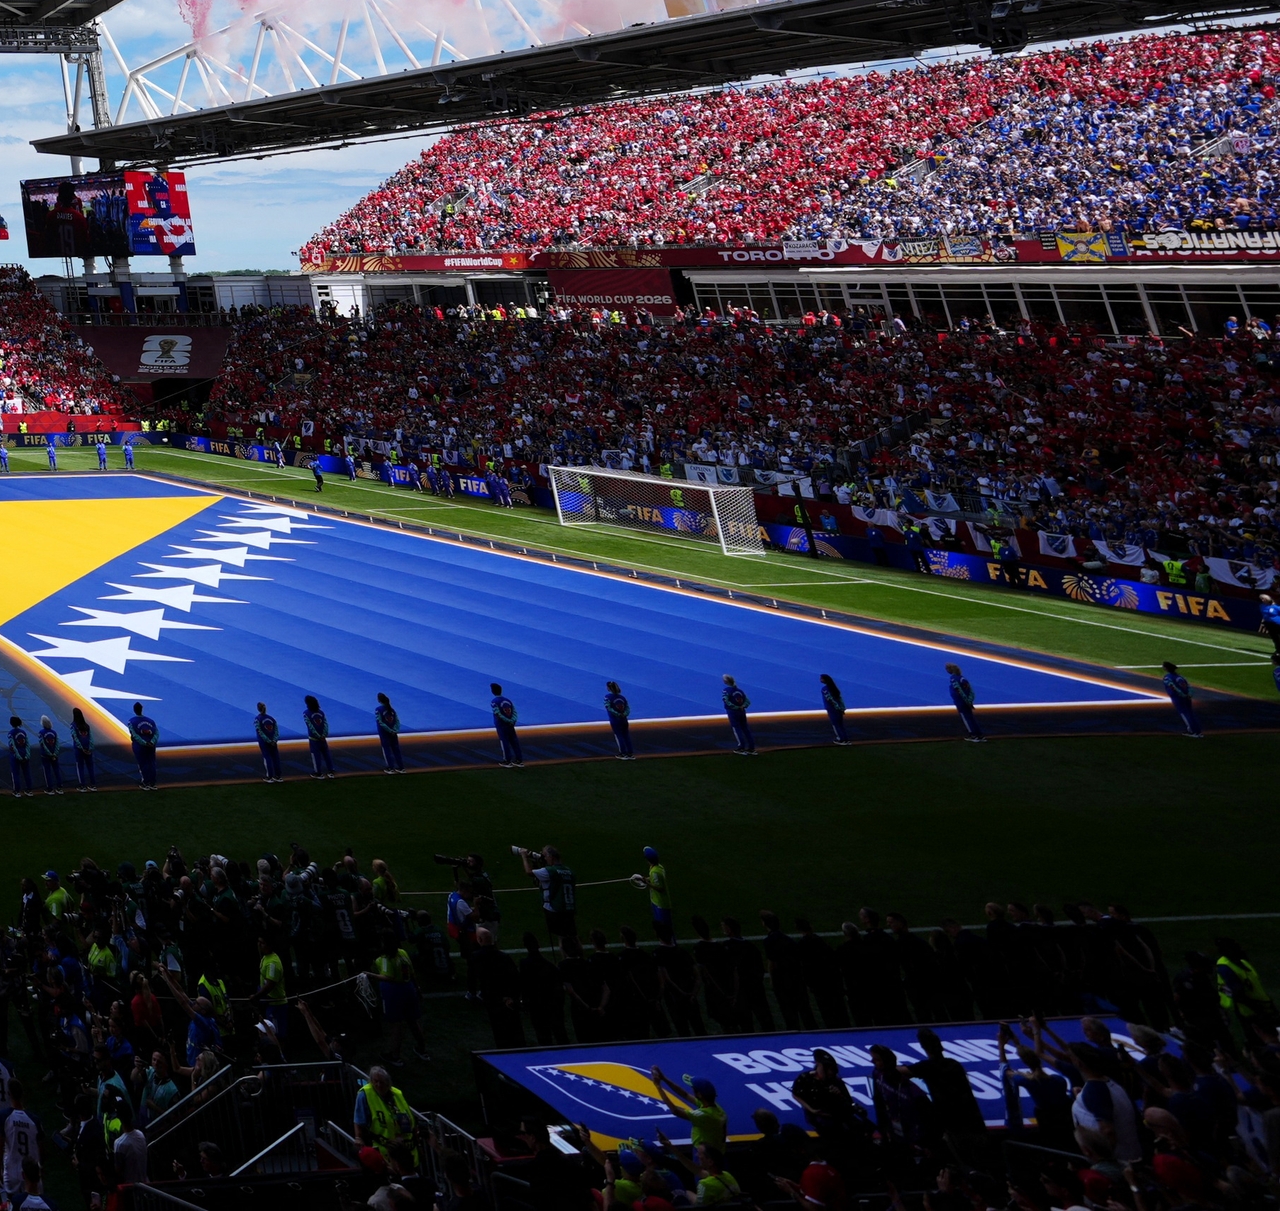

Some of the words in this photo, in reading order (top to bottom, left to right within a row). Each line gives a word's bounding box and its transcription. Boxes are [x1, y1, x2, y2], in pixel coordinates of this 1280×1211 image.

[56, 212, 73, 221] DAVIES
[444, 258, 503, 267] #FIFAWorldCup
[556, 294, 577, 303] FIFA
[578, 295, 612, 305] WORLD
[614, 295, 634, 304] CUP
[635, 295, 672, 304] 2026
[24, 435, 47, 445] FIFA
[88, 434, 111, 444] FIFA
[210, 441, 230, 454] FIFA
[460, 478, 487, 495] FIFA
[1156, 591, 1232, 622] FIFA
[17, 1131, 29, 1156] 9
